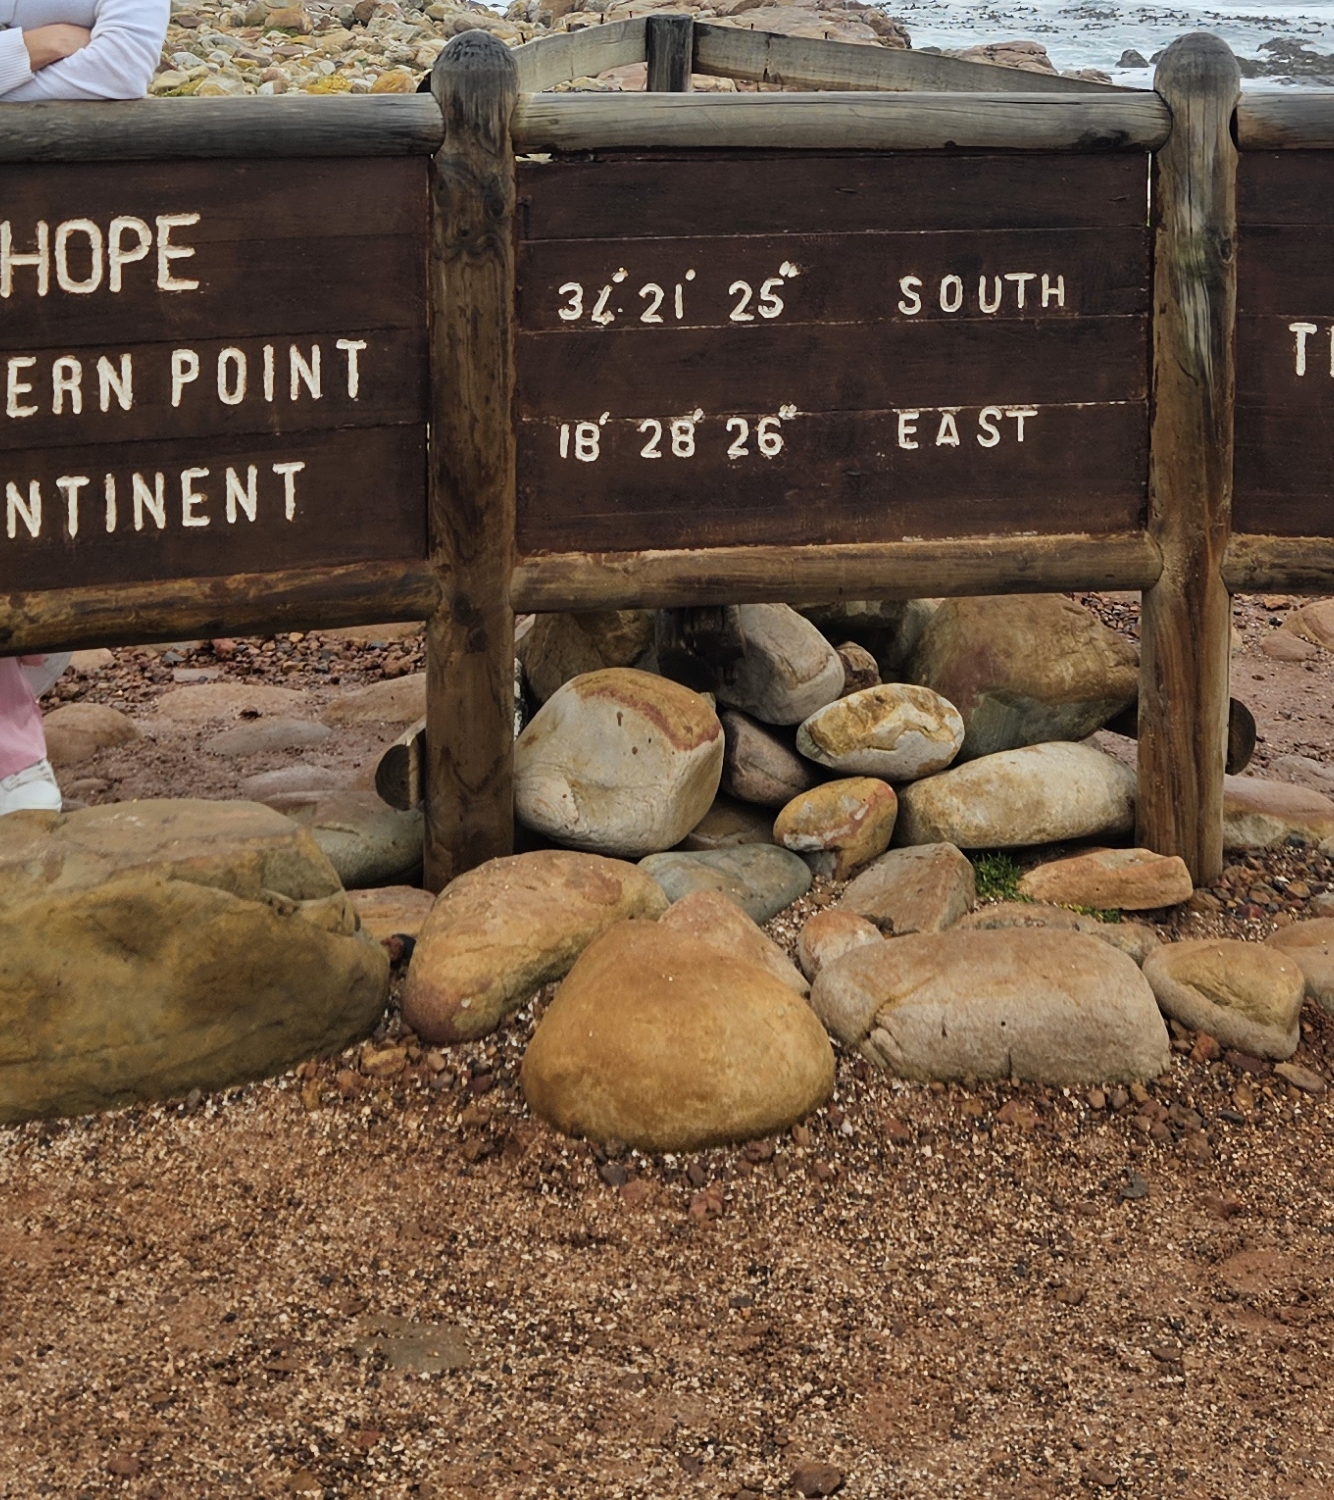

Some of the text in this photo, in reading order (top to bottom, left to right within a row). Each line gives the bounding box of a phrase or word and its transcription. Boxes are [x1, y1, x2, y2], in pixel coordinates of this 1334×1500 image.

[897, 271, 1067, 317] SOUTH
[170, 337, 369, 409] POINT
[896, 405, 1039, 451] EAST
